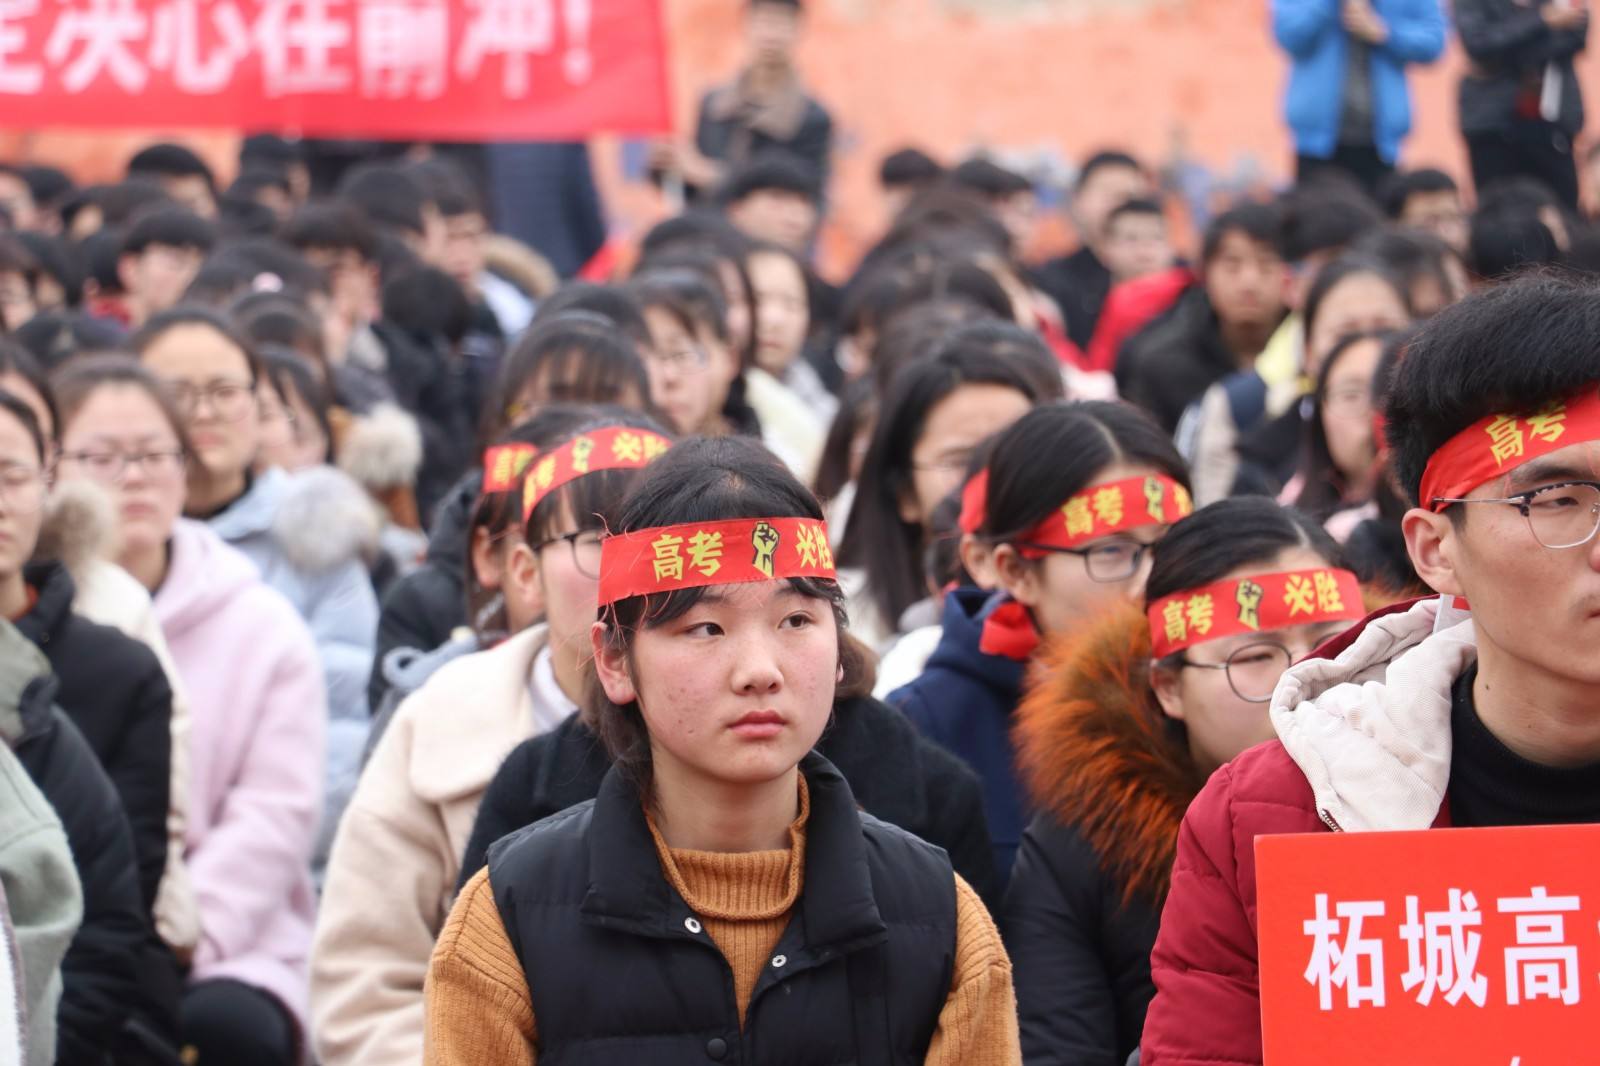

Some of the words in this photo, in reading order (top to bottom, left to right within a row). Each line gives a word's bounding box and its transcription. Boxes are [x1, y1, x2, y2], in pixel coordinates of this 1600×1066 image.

[1485, 406, 1566, 468] 高考
[1062, 487, 1122, 538] 高考
[651, 530, 723, 583] 高考
[1164, 594, 1214, 644] 高考
[1285, 572, 1344, 616] 必胜
[1303, 885, 1600, 1010] 柘城高
